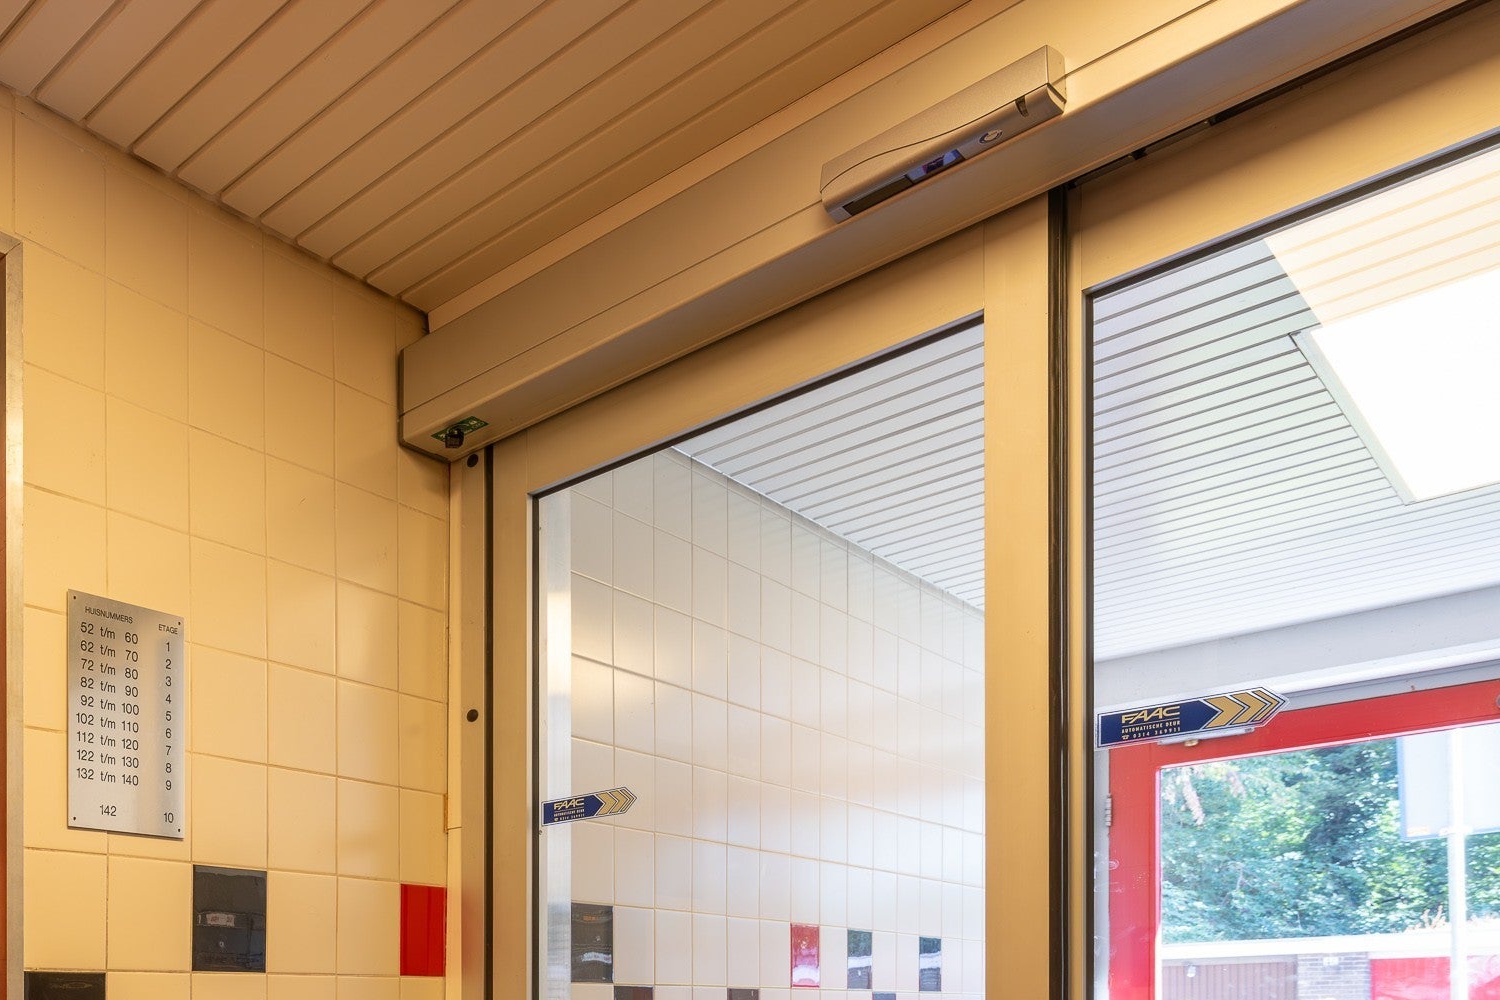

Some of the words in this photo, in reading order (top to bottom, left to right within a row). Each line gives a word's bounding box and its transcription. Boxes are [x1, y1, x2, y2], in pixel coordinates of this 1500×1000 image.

[85, 606, 133, 624] HUISNUMMERS
[80, 622, 94, 634] 52
[100, 627, 115, 639] t/m
[125, 632, 138, 644] 60
[158, 624, 178, 634] ETAGE
[80, 640, 94, 652] 62
[100, 644, 116, 657] t/m
[125, 650, 138, 662] 70
[166, 642, 170, 652] 1
[81, 658, 94, 671] 72
[100, 662, 116, 675] t/m
[125, 668, 138, 680] 80
[165, 659, 172, 669] 2
[80, 676, 94, 689] 82
[100, 681, 116, 693] t/m
[125, 686, 138, 697] 90
[165, 676, 172, 687] 3
[80, 695, 94, 707] 92
[100, 699, 116, 711] t/m
[121, 703, 139, 715] 100
[165, 694, 172, 704] 4
[165, 711, 172, 721] 5
[1121, 706, 1180, 724] FAAC
[76, 713, 94, 725] 102
[100, 717, 116, 729] t/m
[122, 721, 139, 733] 110
[1121, 723, 1163, 734] AUTOMATISCHE
[165, 728, 172, 738] 6
[77, 731, 94, 743] 112
[100, 735, 116, 747] t/m
[122, 739, 139, 751] 120
[165, 745, 172, 755] 7
[77, 749, 94, 761] 122
[100, 753, 116, 765] t/m
[122, 757, 139, 768] 130
[165, 763, 172, 773] 8
[76, 768, 94, 780] 132
[100, 771, 116, 783] t/m
[122, 774, 139, 786] 140
[165, 780, 172, 790] 9
[100, 804, 117, 816] 142
[554, 798, 584, 811] FAAC
[164, 812, 174, 823] 10
